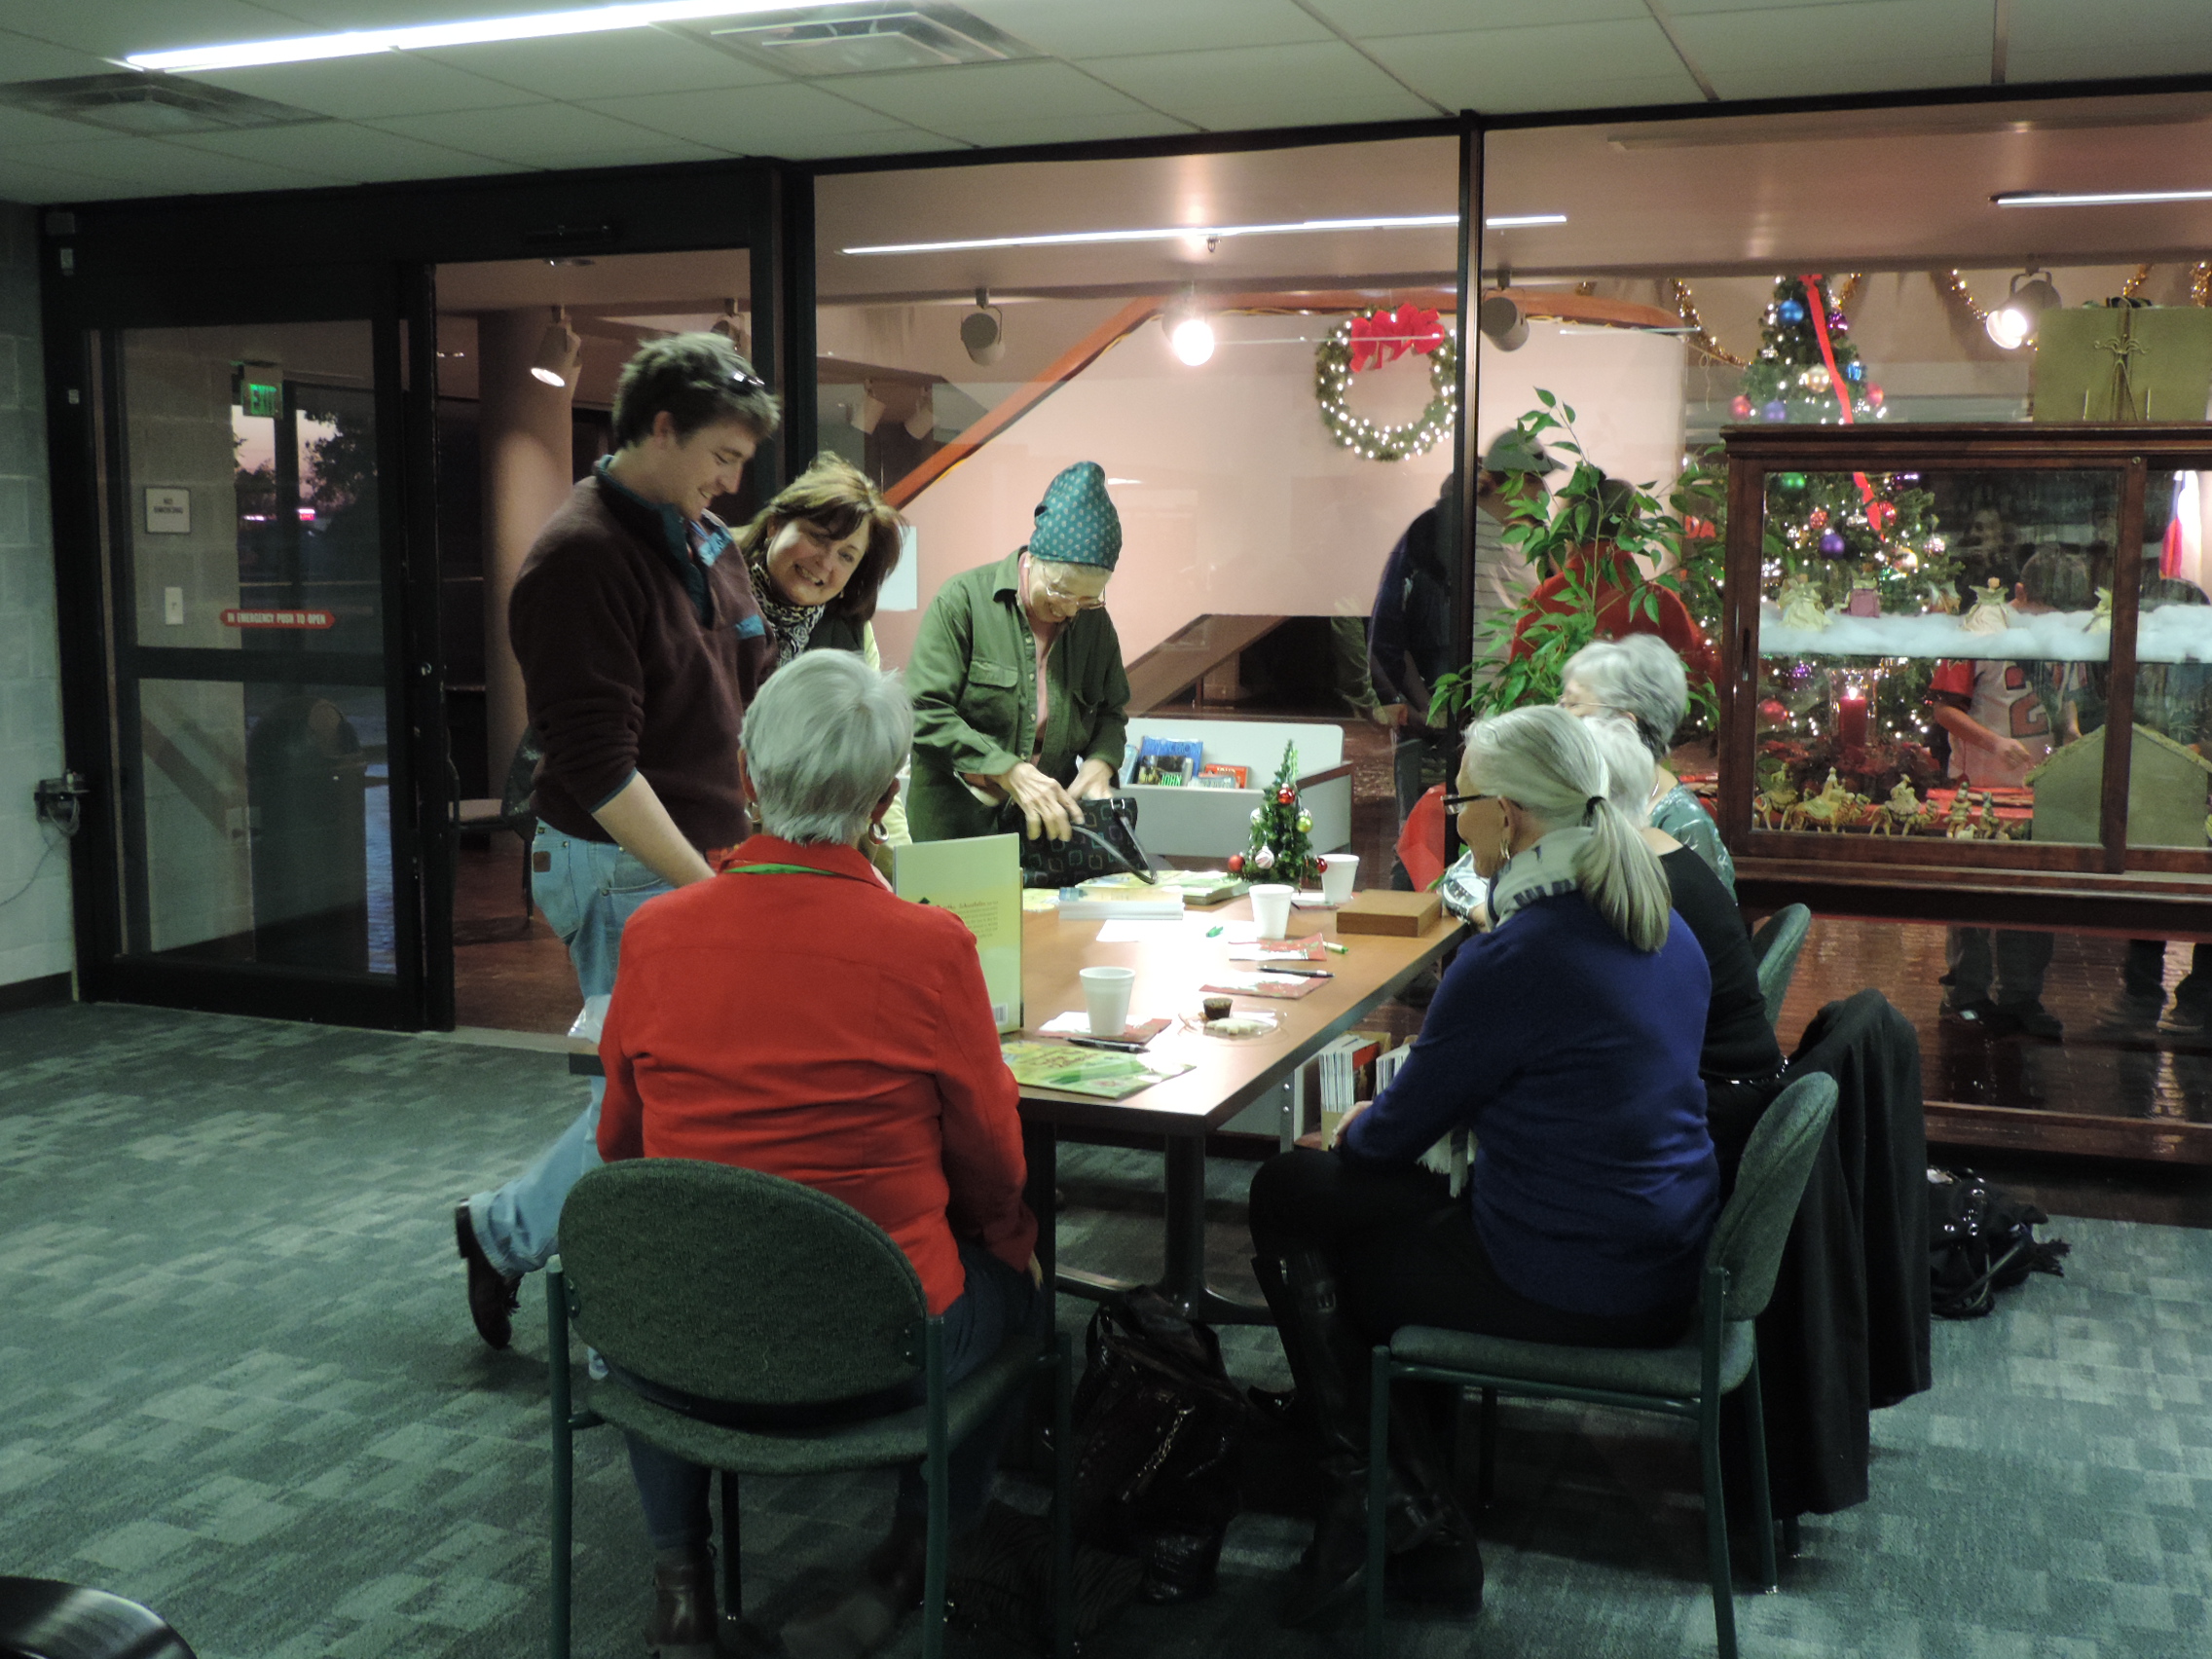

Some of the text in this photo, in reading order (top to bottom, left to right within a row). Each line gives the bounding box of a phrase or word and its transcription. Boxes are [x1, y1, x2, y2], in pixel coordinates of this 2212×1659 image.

[249, 384, 277, 416] EXIT
[227, 612, 326, 625] IN EMERGENCY PUSH TO OPEN
[1158, 773, 1183, 787] JOHN
